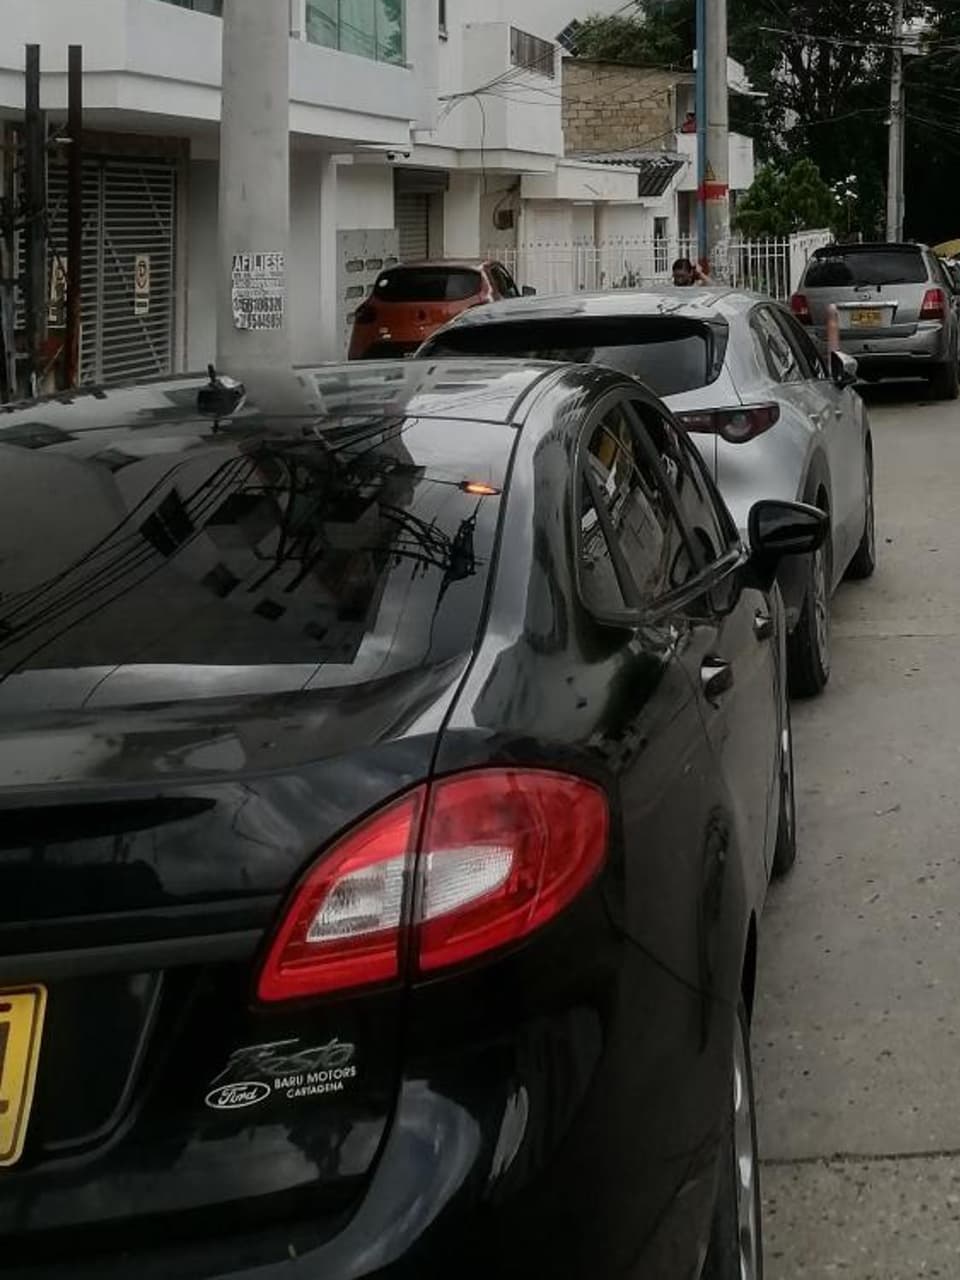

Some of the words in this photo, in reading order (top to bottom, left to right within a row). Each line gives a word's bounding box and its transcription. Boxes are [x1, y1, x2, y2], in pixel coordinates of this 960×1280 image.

[274, 1074, 303, 1089] BARU
[307, 1066, 356, 1084] MOTORS
[219, 1085, 258, 1105] Ford
